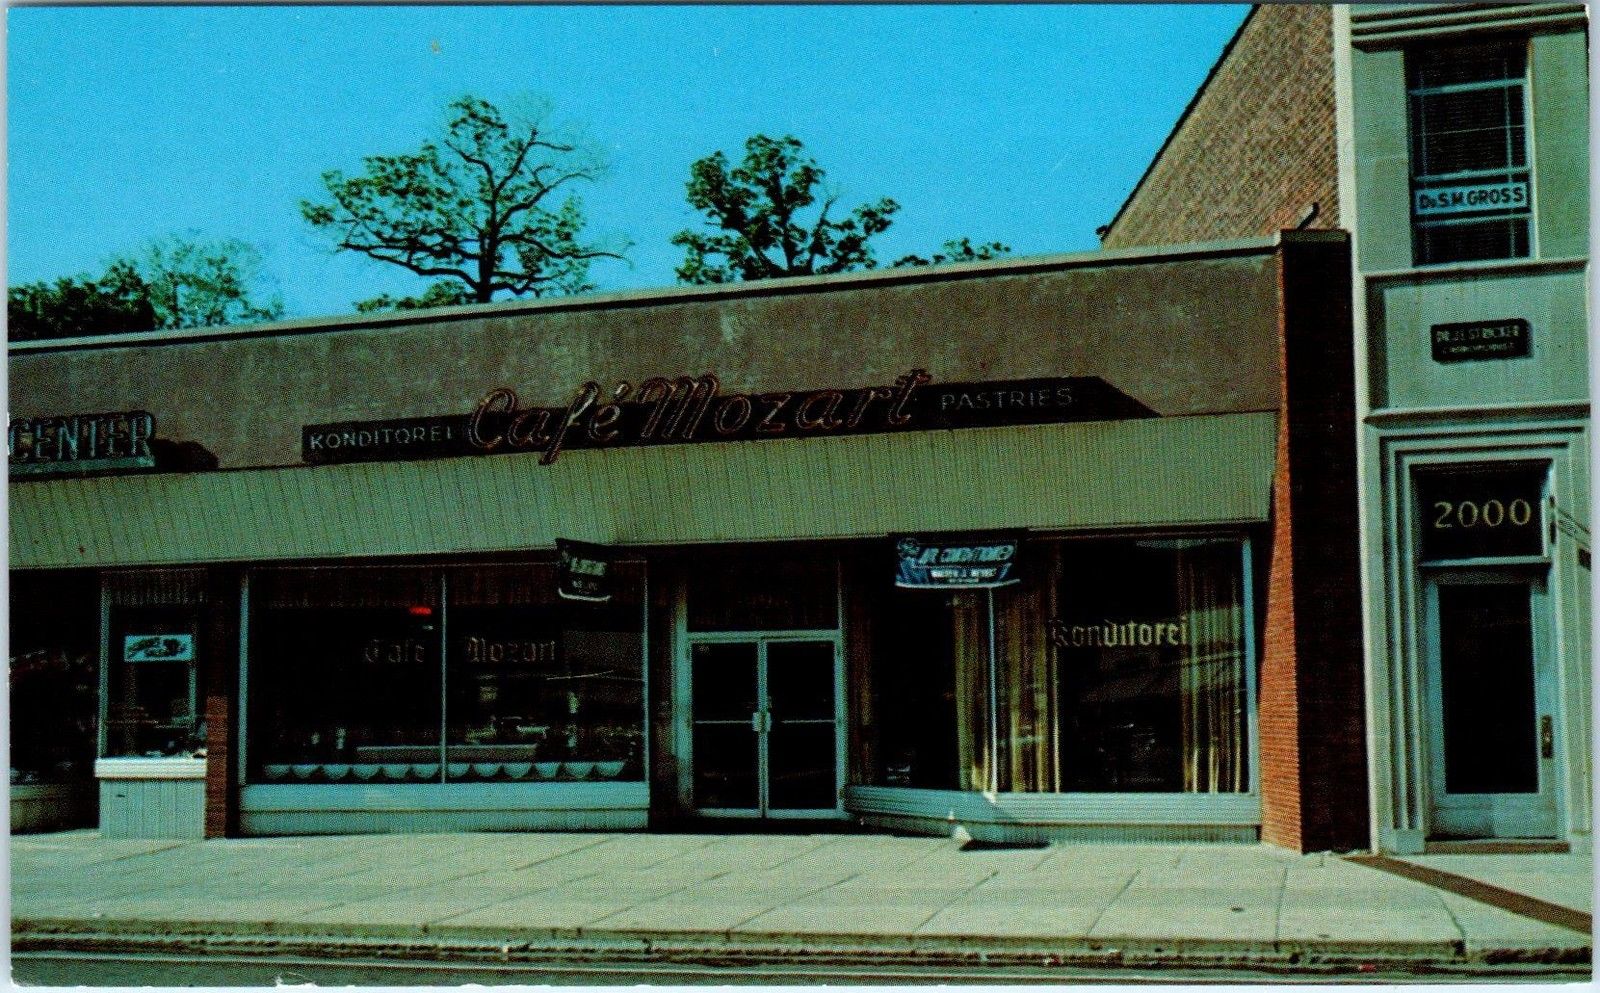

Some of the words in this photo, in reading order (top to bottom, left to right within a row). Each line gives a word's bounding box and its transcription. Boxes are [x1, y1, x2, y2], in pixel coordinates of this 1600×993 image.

[1467, 186, 1525, 206] GROSS
[940, 386, 1074, 411] PASTRIES
[468, 382, 631, 465] Café
[634, 368, 933, 441] Mozart
[9, 414, 154, 460] CENTER
[309, 426, 452, 450] KONDITOREI
[1434, 499, 1532, 529] 2000
[1048, 615, 1189, 648] Konditorei
